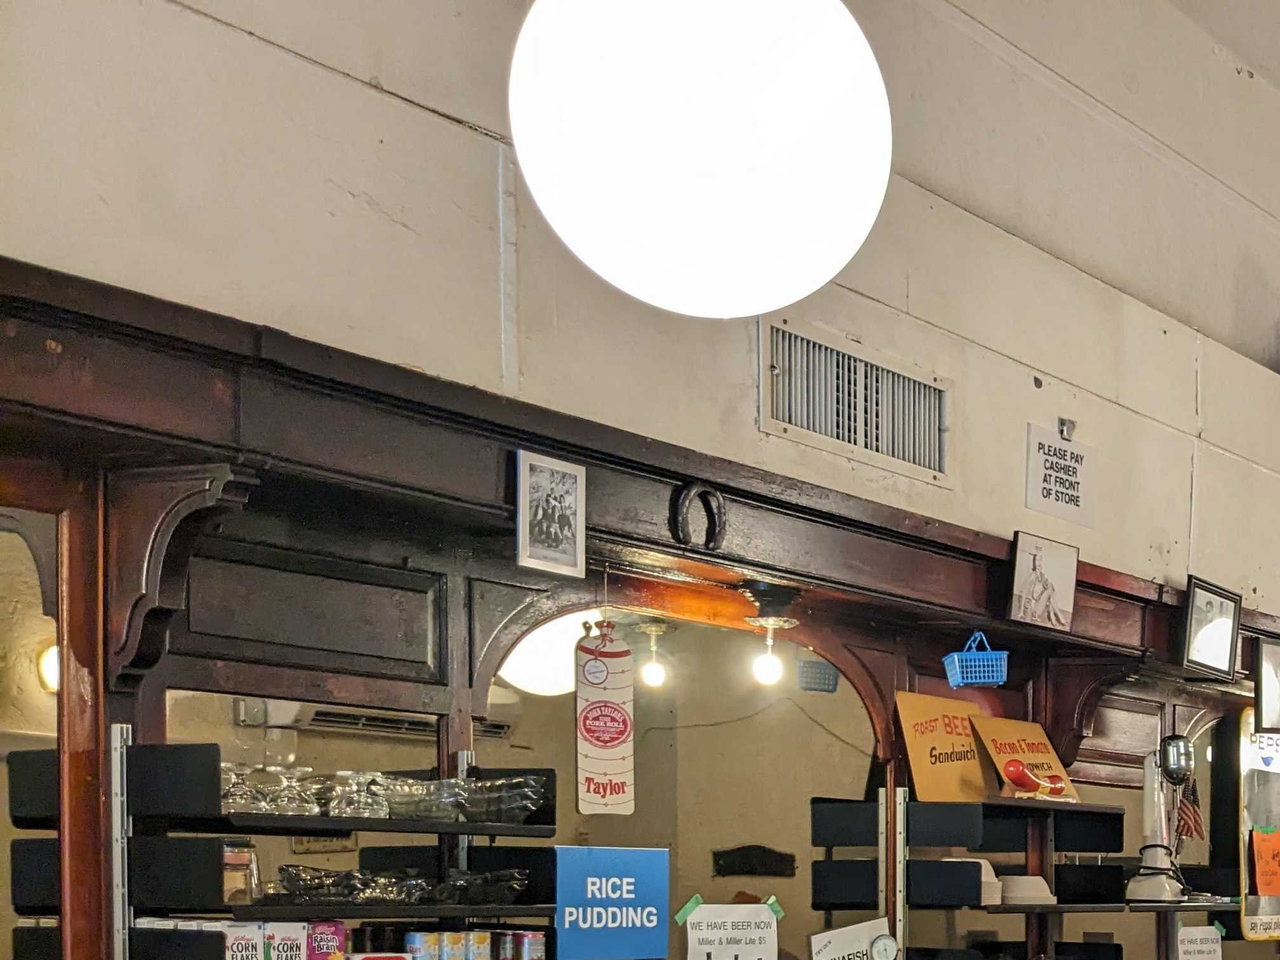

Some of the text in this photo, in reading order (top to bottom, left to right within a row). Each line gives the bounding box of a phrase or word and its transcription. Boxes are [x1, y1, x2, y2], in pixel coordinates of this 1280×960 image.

[1037, 441, 1084, 466] PLEASE PAY
[1043, 458, 1078, 478] CASHIER
[1042, 472, 1080, 493] AT FRONT
[1041, 486, 1081, 508] OF STORE
[912, 714, 973, 739] ROAST BEE
[929, 743, 976, 766] Sandwich
[990, 738, 1017, 755] Bacon
[1022, 738, 1051, 755] Tomato
[584, 776, 628, 798] Taylor
[587, 877, 636, 899] RICE
[564, 906, 658, 929] PUDDING
[689, 920, 773, 931] WE HAVE BEER NOW
[230, 942, 258, 953] CORN
[276, 942, 302, 953] CORN
[313, 934, 338, 945] Raisin
[316, 943, 336, 952] Bran
[697, 936, 767, 946] Miller & Miller Lite $5
